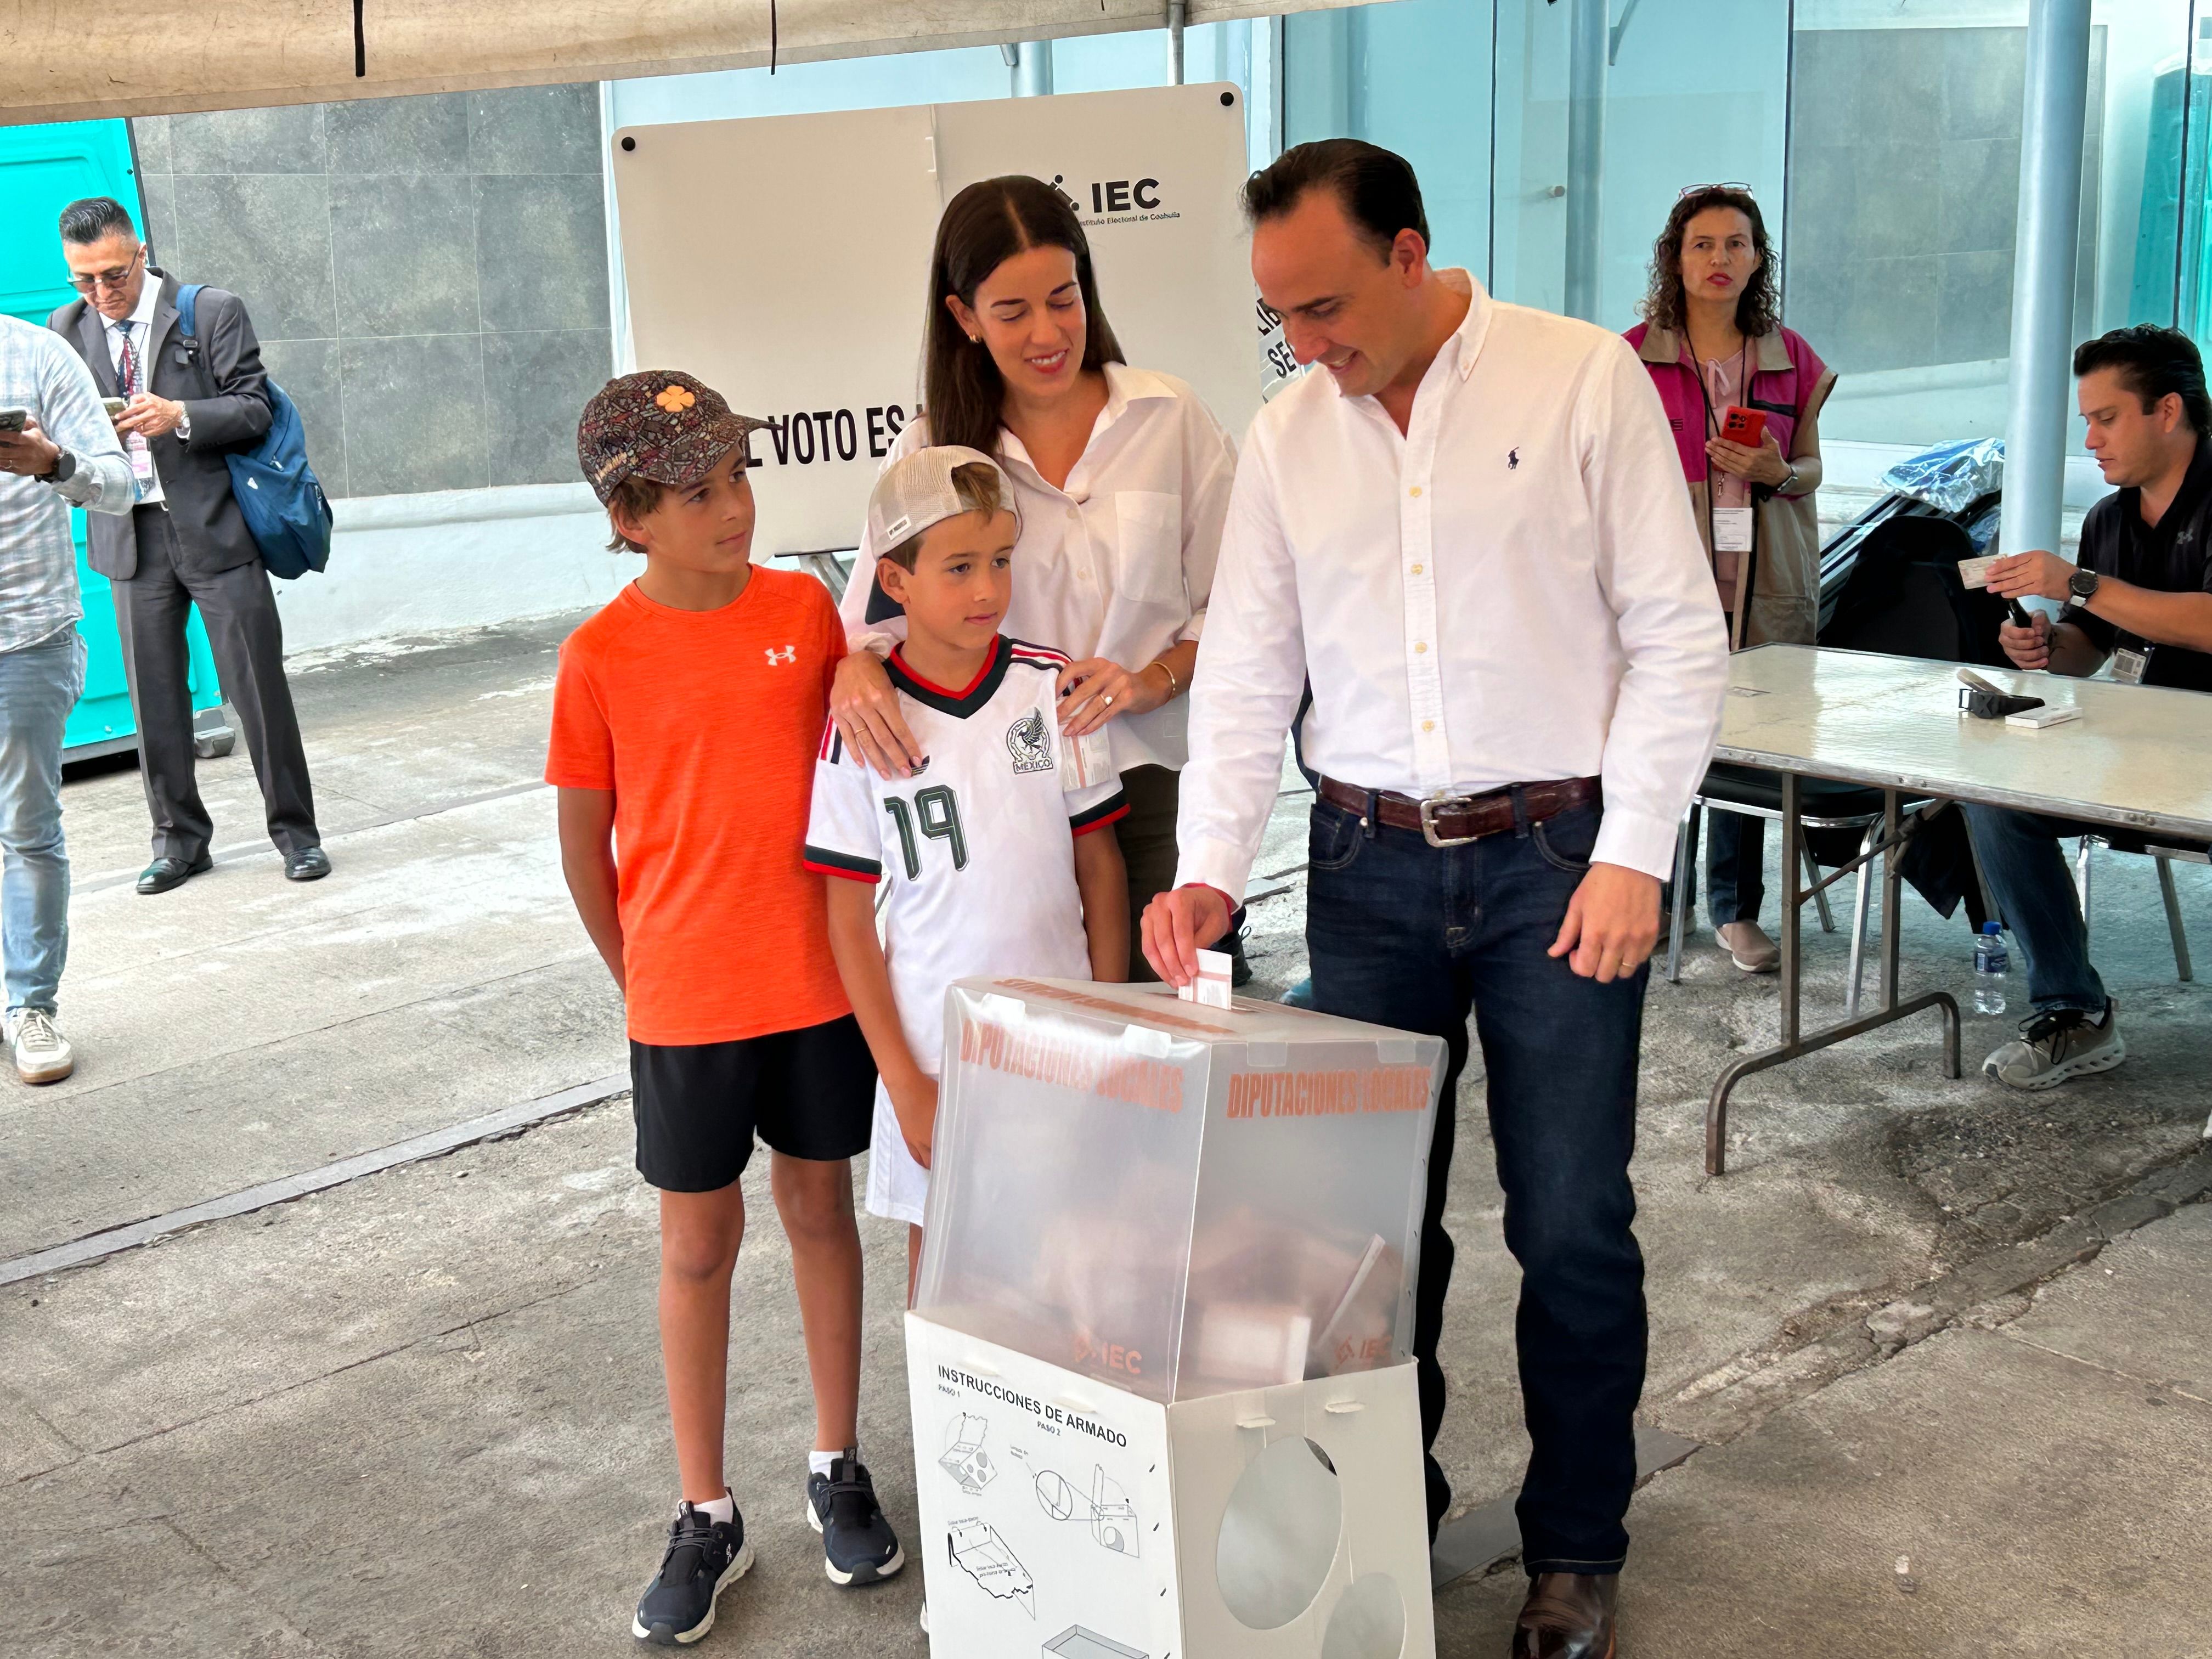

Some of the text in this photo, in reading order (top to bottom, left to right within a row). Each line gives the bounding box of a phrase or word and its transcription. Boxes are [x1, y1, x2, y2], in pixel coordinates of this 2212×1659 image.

[1092, 178, 1161, 213] IEC
[768, 409, 857, 465] VOTO
[866, 404, 905, 458] ES
[883, 785, 970, 882] 19
[1227, 1069, 1358, 1118] DIPUTACIONES
[1102, 1342, 1142, 1374] IEC
[938, 1364, 1127, 1447] INSTRUCCIONES DE ARMADO
[1037, 1420, 1055, 1434] PASO
